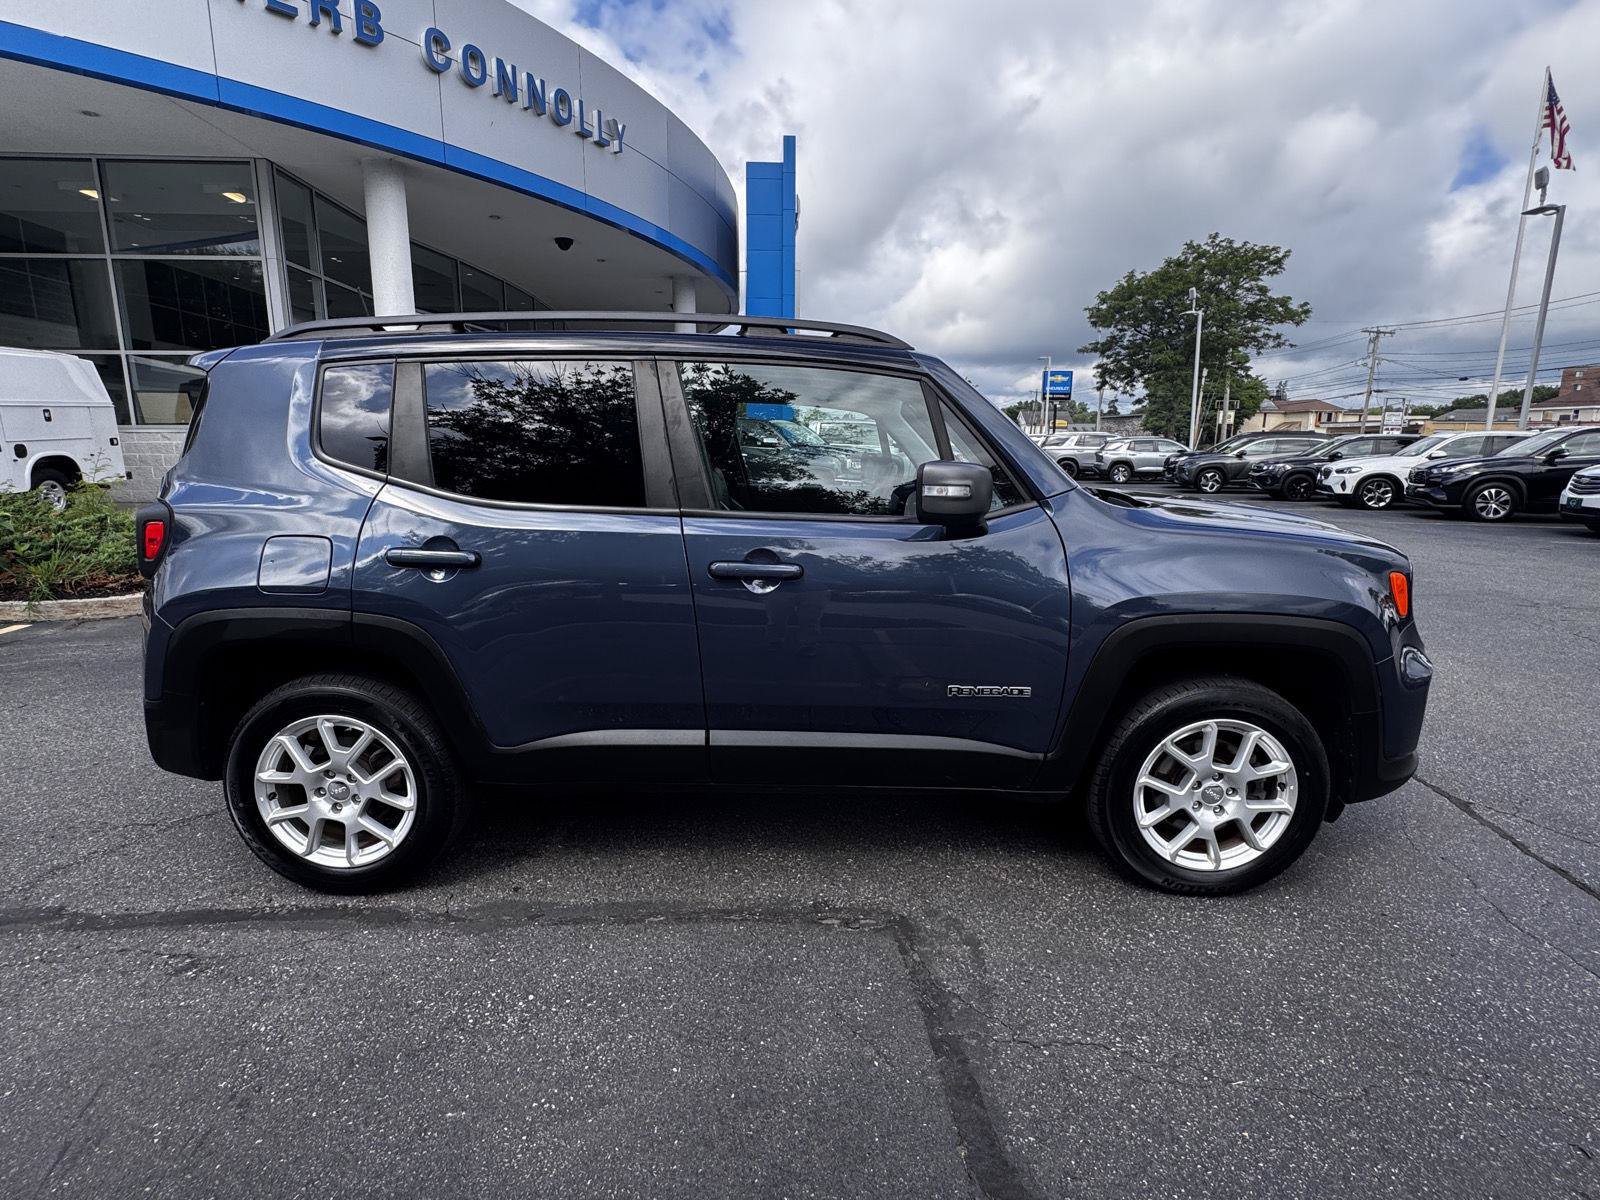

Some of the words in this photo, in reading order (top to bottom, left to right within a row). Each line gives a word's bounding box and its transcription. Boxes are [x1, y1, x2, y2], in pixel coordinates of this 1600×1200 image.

[236, 0, 385, 47] RB
[420, 27, 627, 154] CONNOLLY
[947, 685, 1032, 697] RENEGADE
